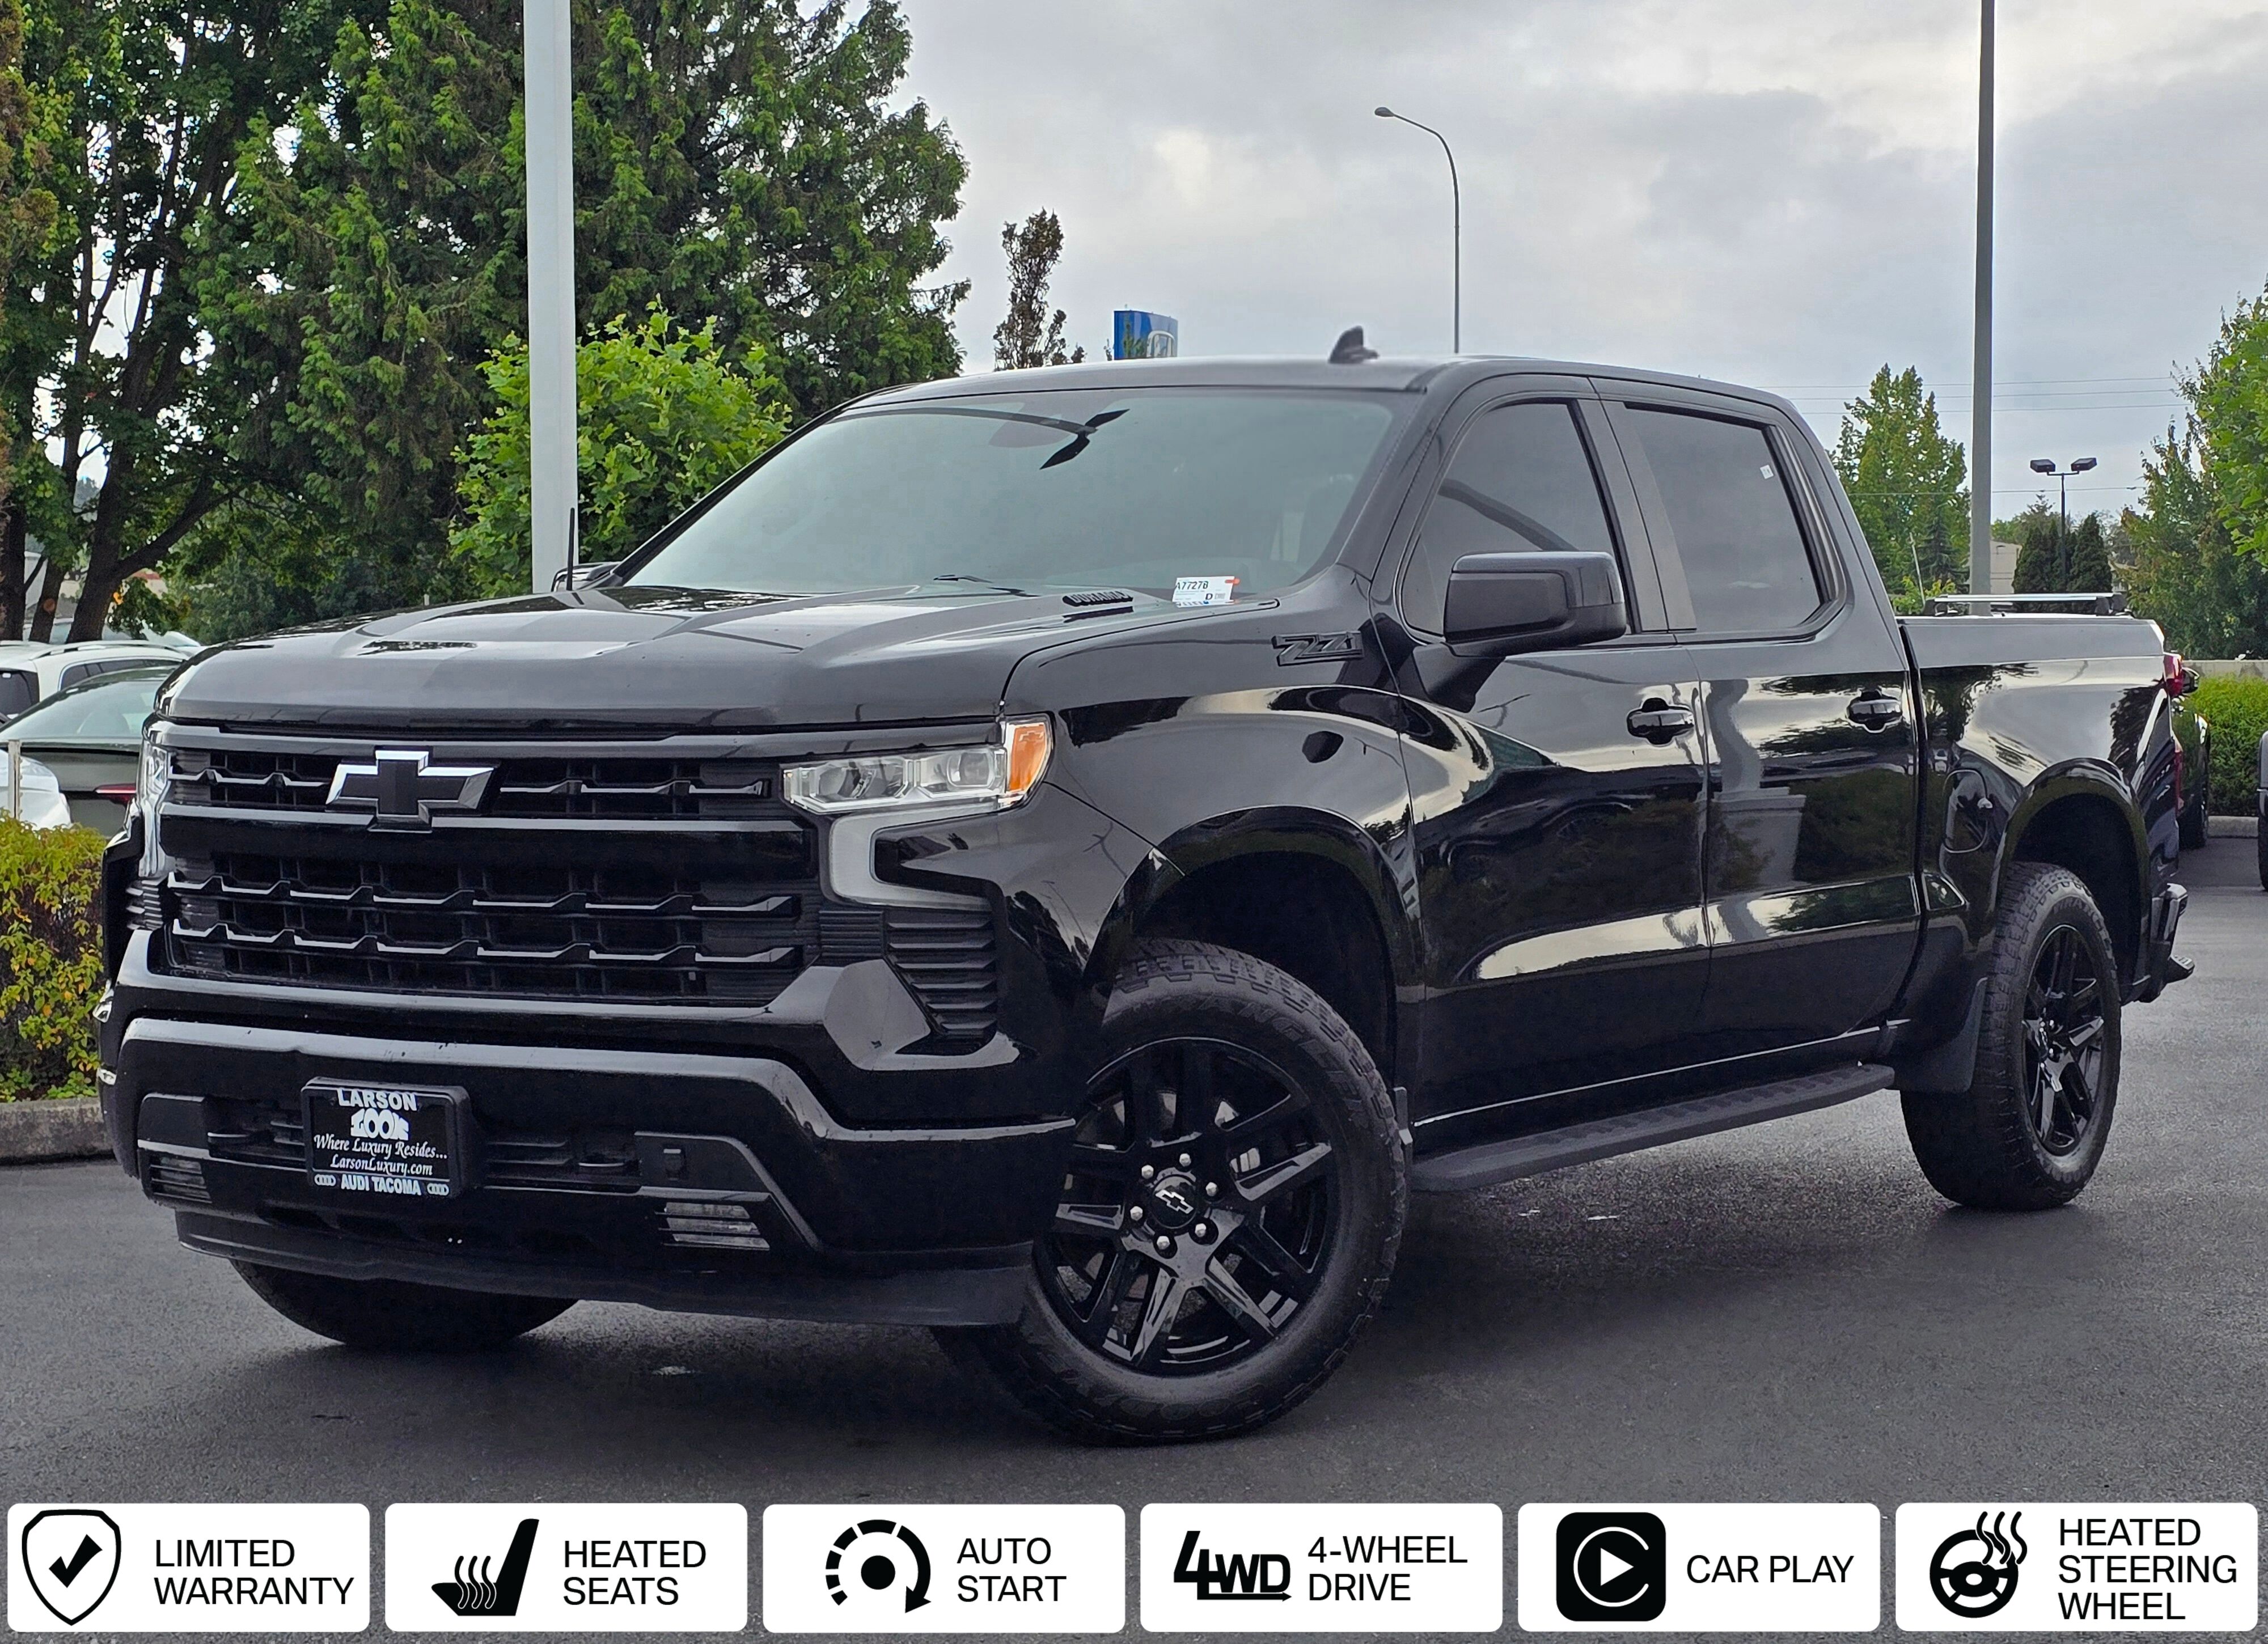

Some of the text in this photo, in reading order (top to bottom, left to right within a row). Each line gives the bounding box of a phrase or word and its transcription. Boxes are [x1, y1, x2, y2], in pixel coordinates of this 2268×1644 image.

[336, 1088, 417, 1111] LARSON
[314, 1134, 349, 1151] Where
[352, 1138, 392, 1159] Luxury
[330, 1154, 433, 1176] LarsonLuxury.com
[341, 1174, 421, 1195] AUDI TACOMA
